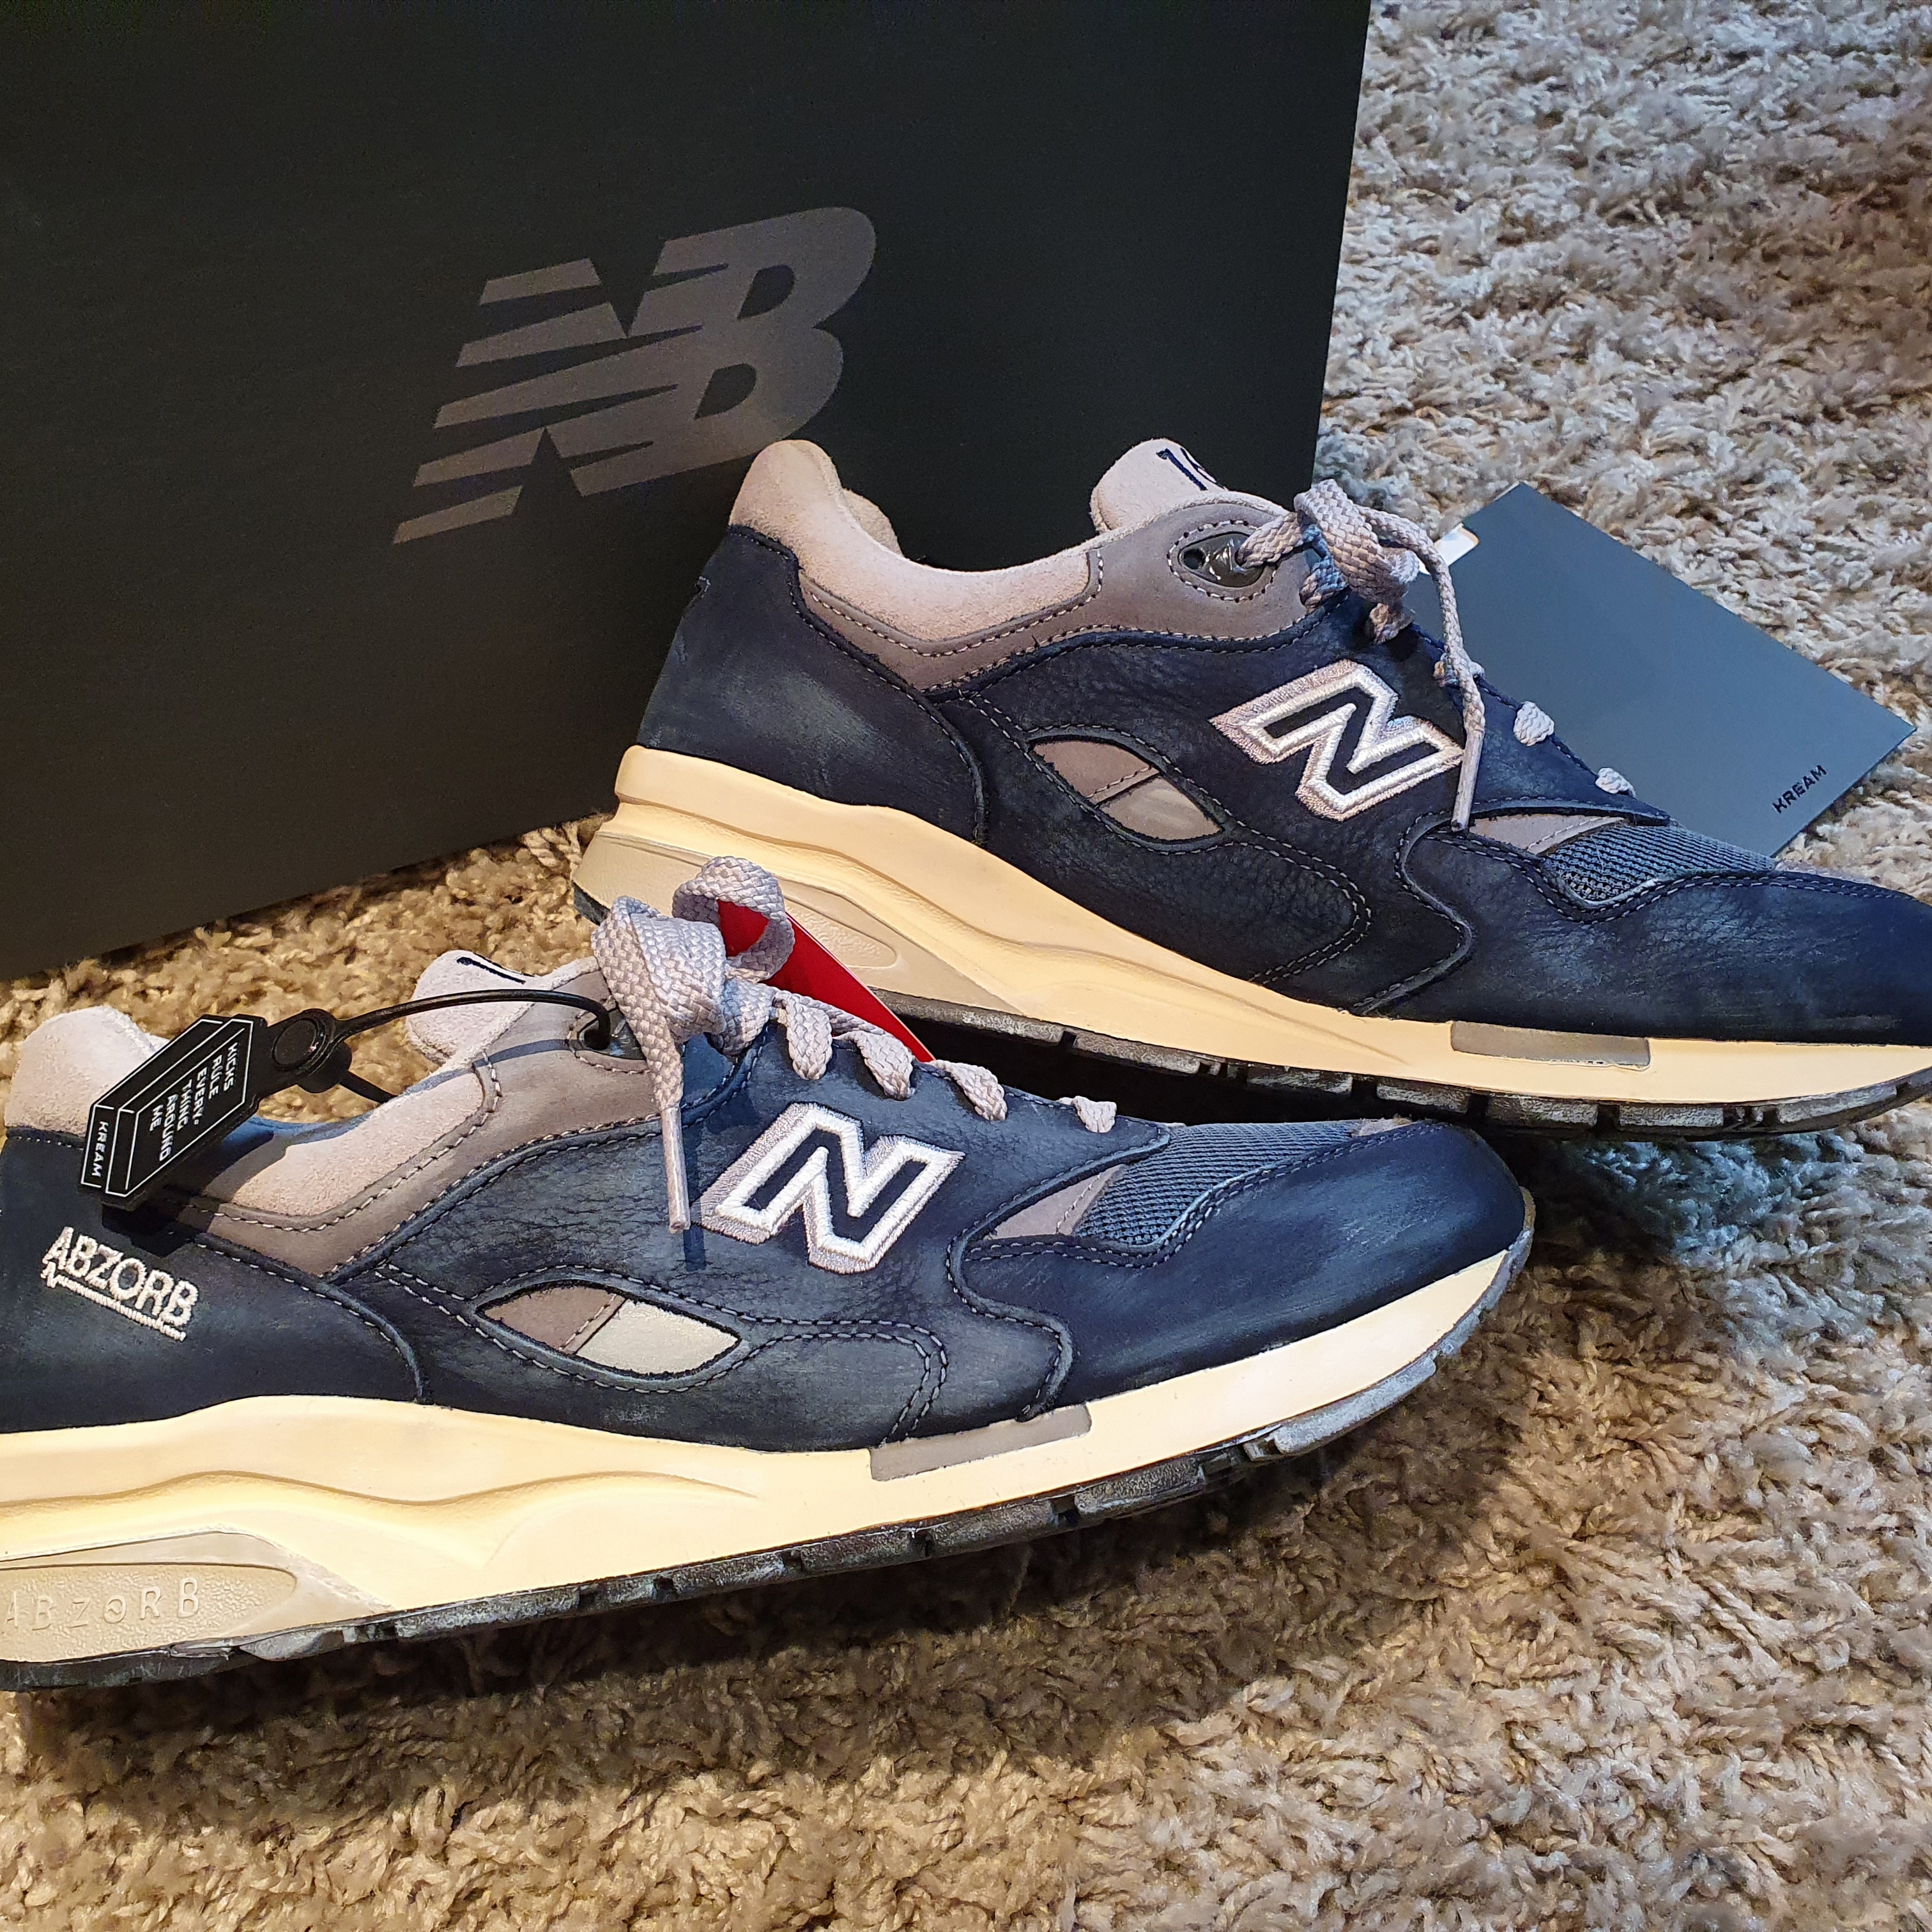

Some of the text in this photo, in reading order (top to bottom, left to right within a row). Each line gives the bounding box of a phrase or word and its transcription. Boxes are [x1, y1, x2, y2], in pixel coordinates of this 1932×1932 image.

[393, 206, 877, 544] NB
[1208, 659, 1464, 821] N
[1772, 764, 1827, 814] KREAM
[208, 1055, 223, 1100] RULE
[224, 1042, 238, 1091] KICKS
[149, 1104, 164, 1131] ME
[176, 1079, 192, 1131] THING
[192, 1067, 208, 1125] EVERY-
[91, 1121, 109, 1178] KREAM
[160, 1094, 178, 1162] AROUND
[691, 1100, 966, 1275] N
[42, 1225, 199, 1327] ABZORB
[1, 1576, 200, 1635] ABZORB
